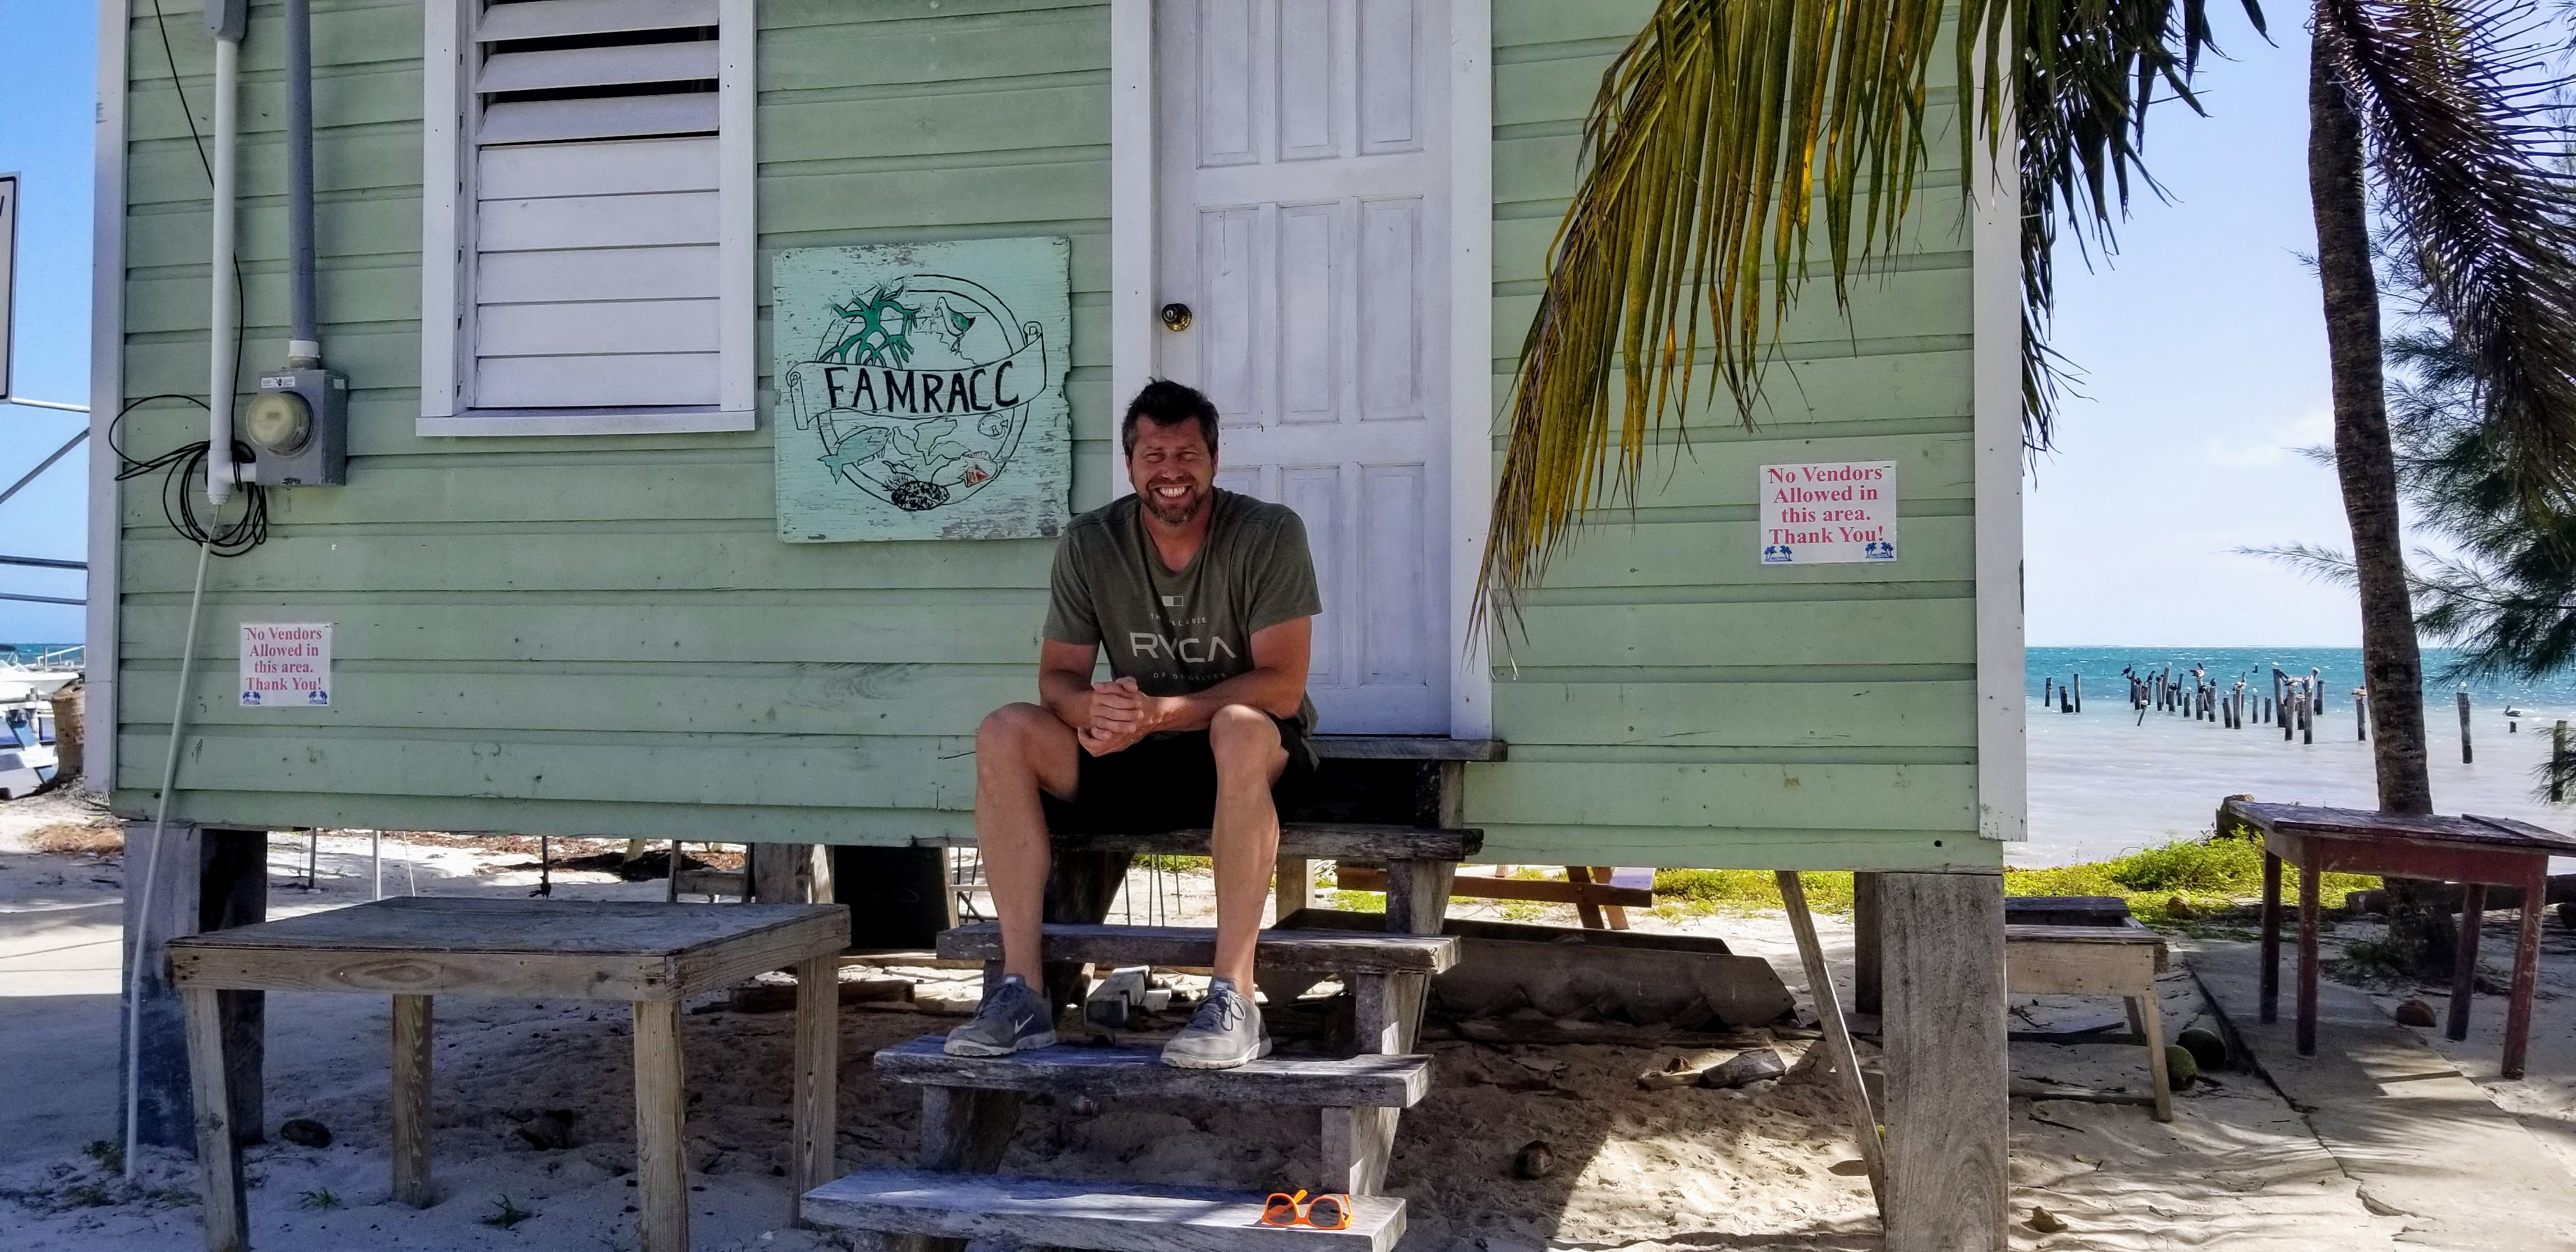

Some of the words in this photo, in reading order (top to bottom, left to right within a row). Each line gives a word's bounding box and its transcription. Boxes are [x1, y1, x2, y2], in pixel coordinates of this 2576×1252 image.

[824, 361, 1019, 413] FAMRACC
[1767, 468, 1796, 484] No
[1802, 465, 1882, 482] Vendors
[1774, 485, 1853, 503] Allowed
[1859, 485, 1878, 500] in
[1781, 507, 1816, 523] this
[1823, 509, 1871, 522] area.
[1768, 528, 1834, 544] Thank
[1838, 525, 1883, 543] You!
[246, 627, 264, 640] No
[269, 627, 322, 640] Vendors
[250, 643, 302, 657] Allowed
[307, 643, 319, 656] in
[1130, 632, 1237, 663] RVCA
[254, 660, 277, 673] this
[281, 662, 313, 673] area.
[245, 678, 287, 690] Thank
[292, 677, 321, 690] You!
